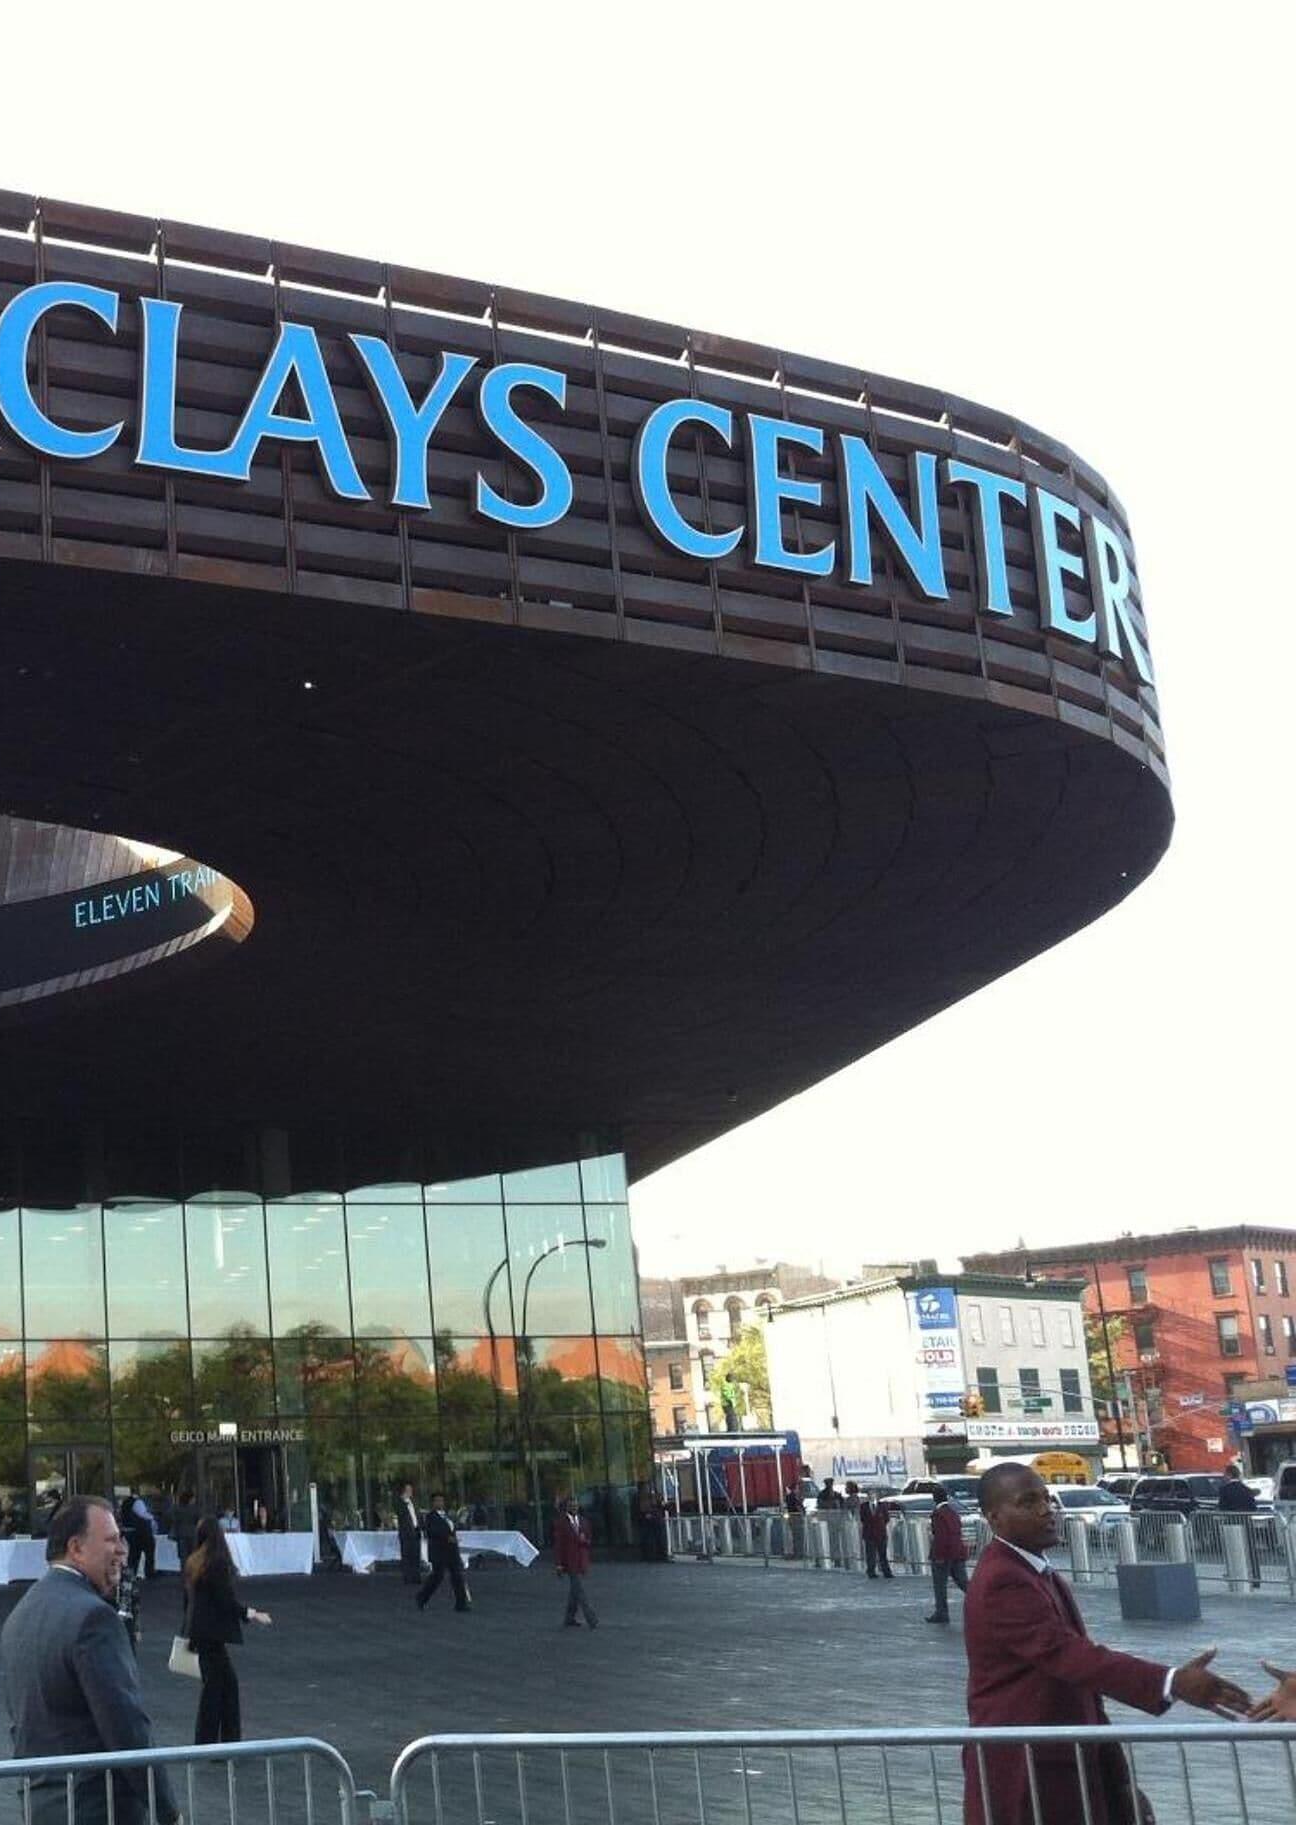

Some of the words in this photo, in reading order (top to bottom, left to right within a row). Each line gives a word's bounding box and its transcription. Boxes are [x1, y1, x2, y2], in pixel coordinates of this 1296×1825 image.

[638, 398, 1154, 687] CENTER
[75, 881, 160, 928] ELEVEN
[170, 1430, 204, 1443] GEICO
[240, 1429, 305, 1442] ENTRANCE
